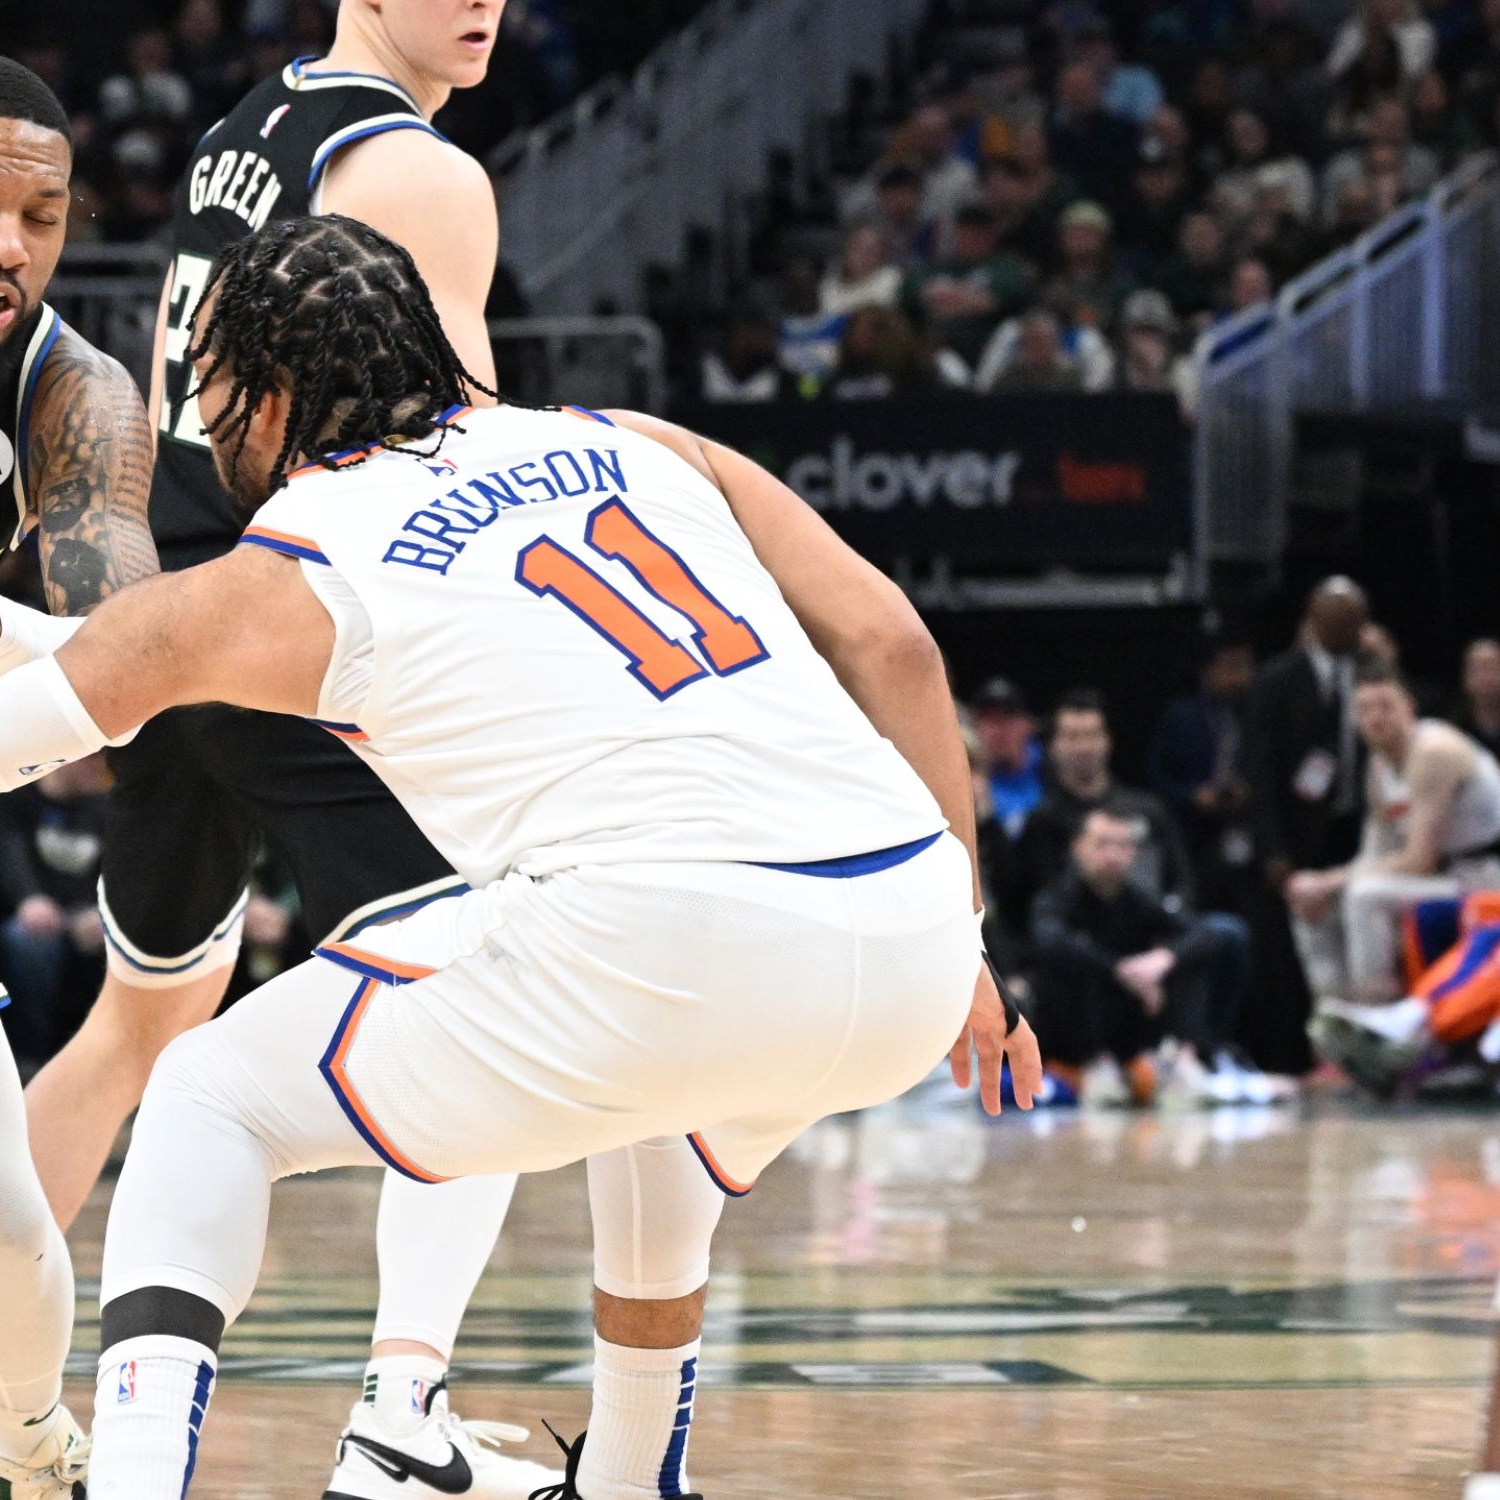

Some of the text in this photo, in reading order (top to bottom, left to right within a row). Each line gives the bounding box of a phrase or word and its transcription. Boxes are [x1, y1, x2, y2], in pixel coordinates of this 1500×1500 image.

[189, 150, 283, 234] GREEN
[381, 448, 628, 576] BRUNSON
[786, 434, 1020, 510] clover
[514, 494, 772, 703] 11
